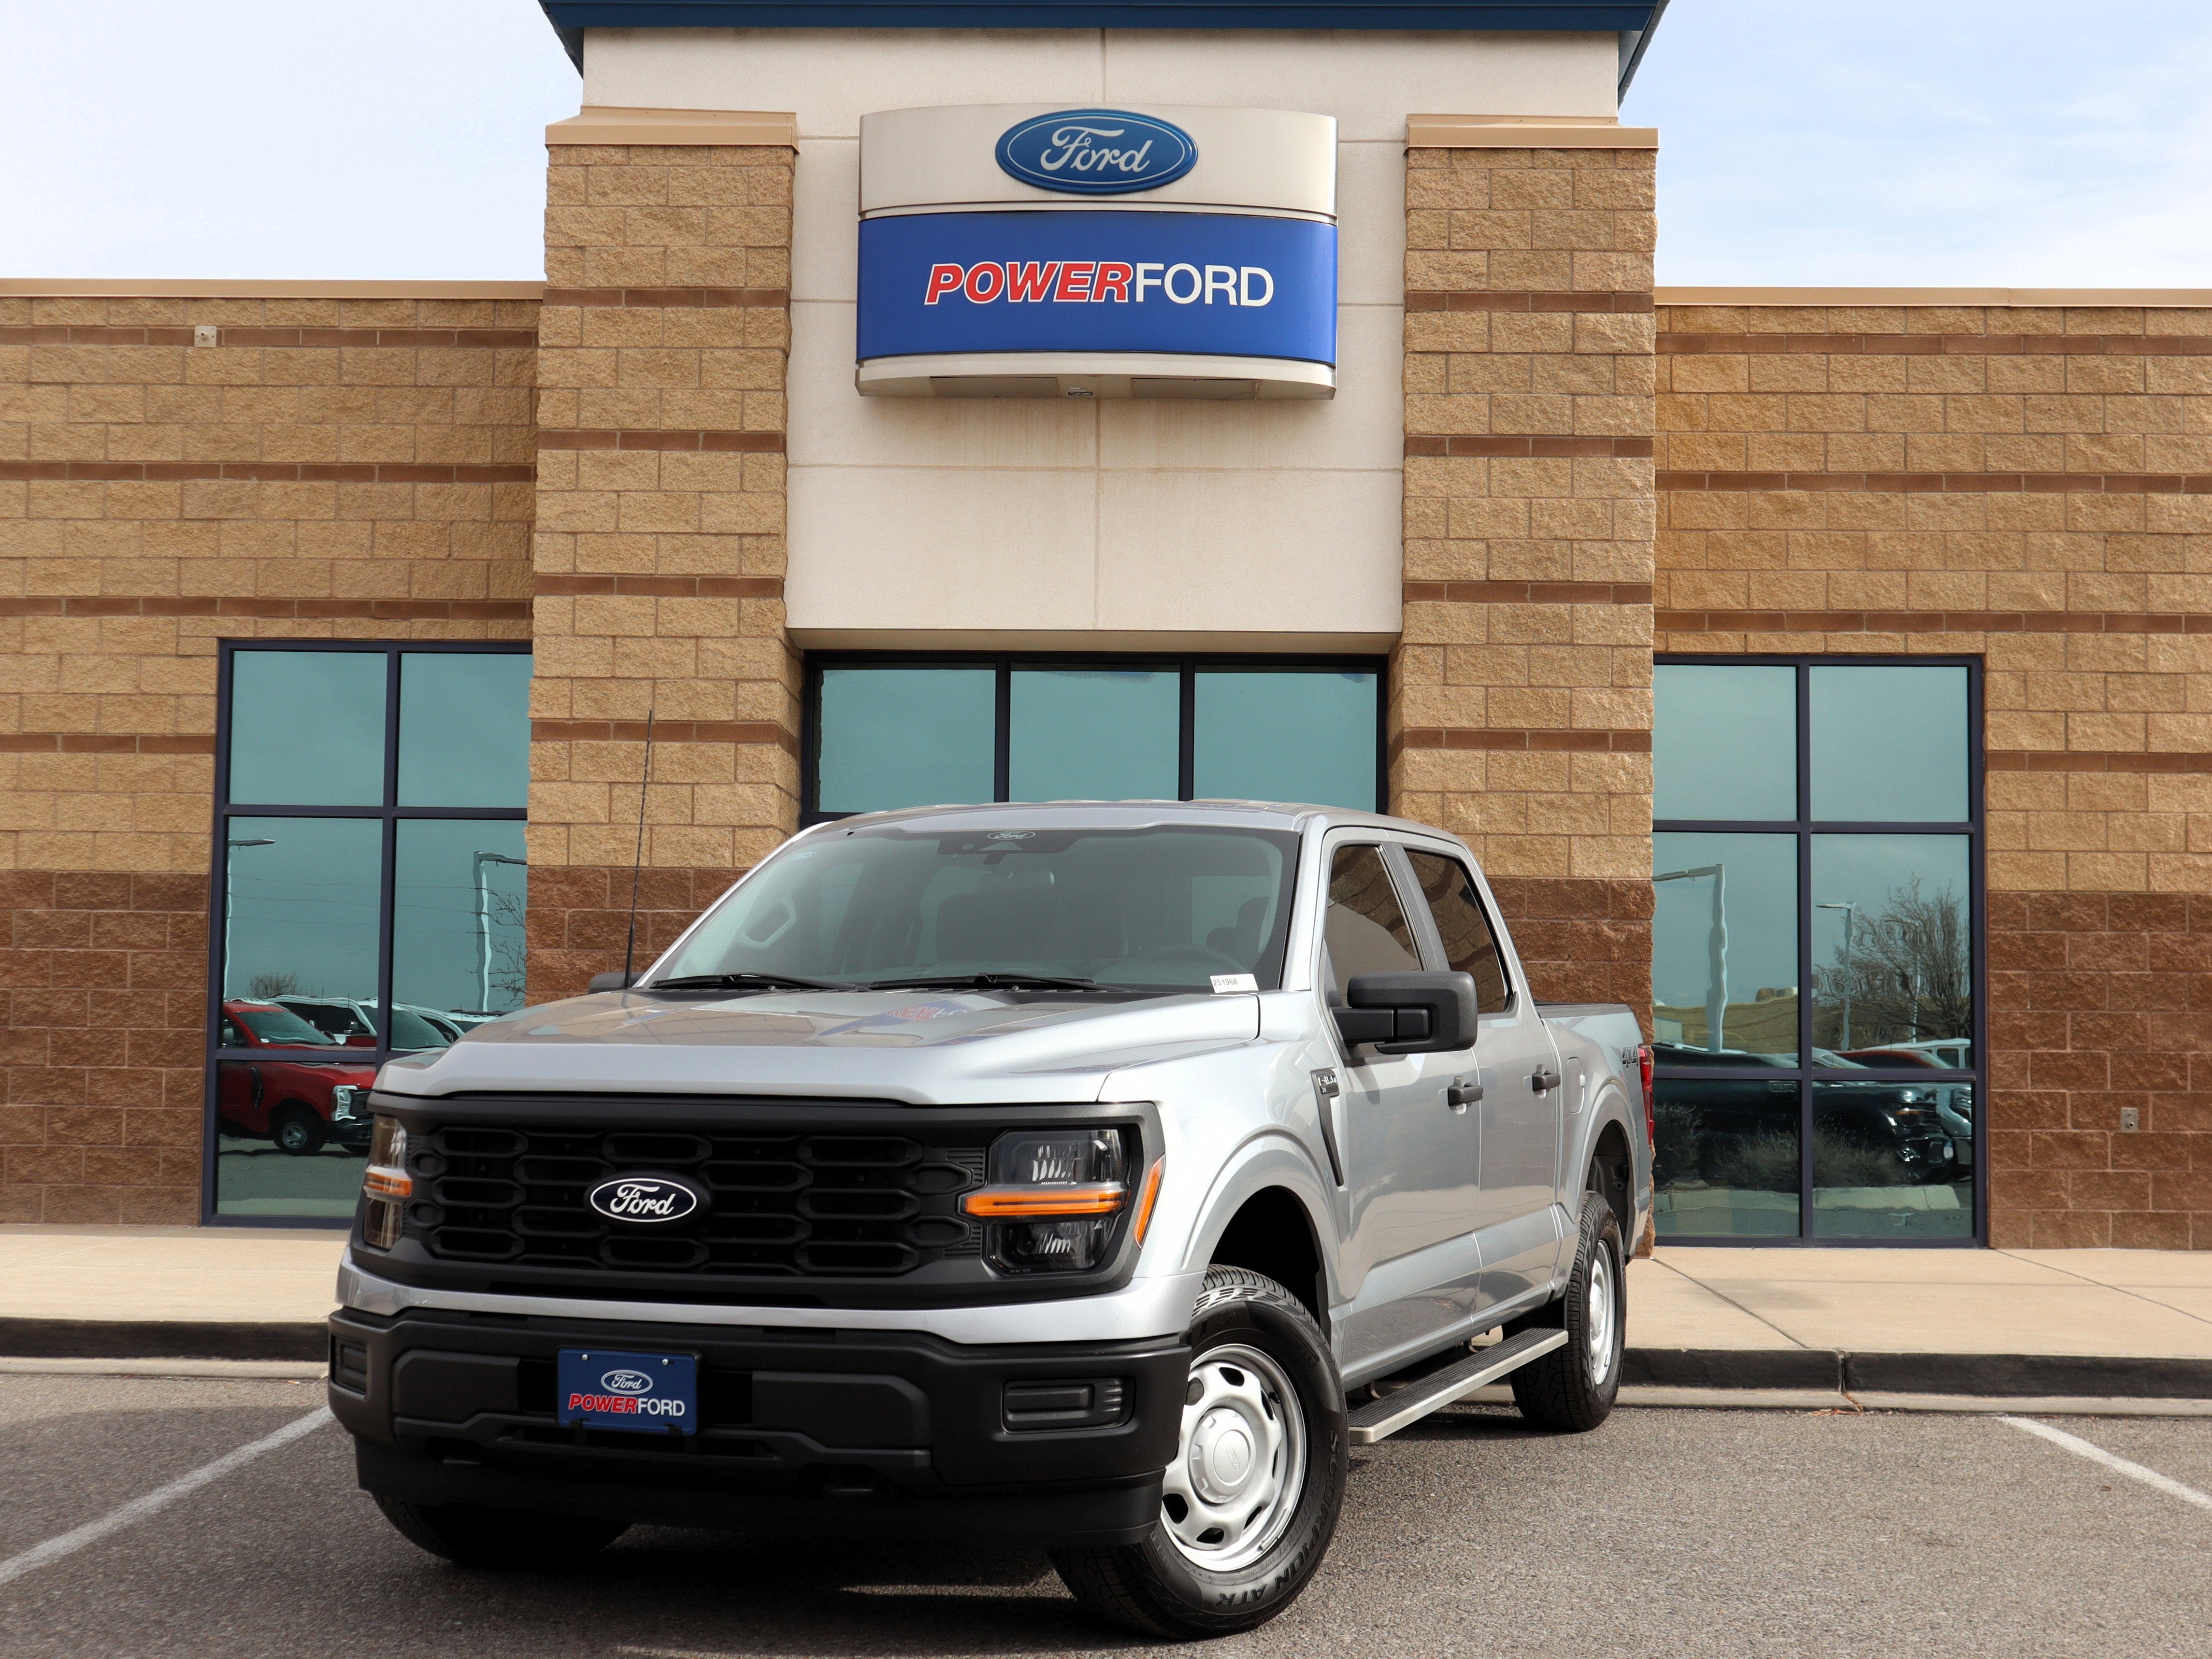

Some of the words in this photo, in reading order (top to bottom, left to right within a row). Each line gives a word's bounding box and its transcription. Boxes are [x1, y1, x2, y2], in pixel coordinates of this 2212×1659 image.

[1040, 125, 1153, 172] Ford
[924, 261, 1274, 307] POWERFORD
[1213, 978, 1238, 986] 251968
[610, 1184, 675, 1216] Ford
[611, 1373, 642, 1390] Ford
[568, 1393, 685, 1416] POWERFORD
[1275, 1430, 1339, 1592] SCORPION
[1215, 1584, 1268, 1608] ATR
